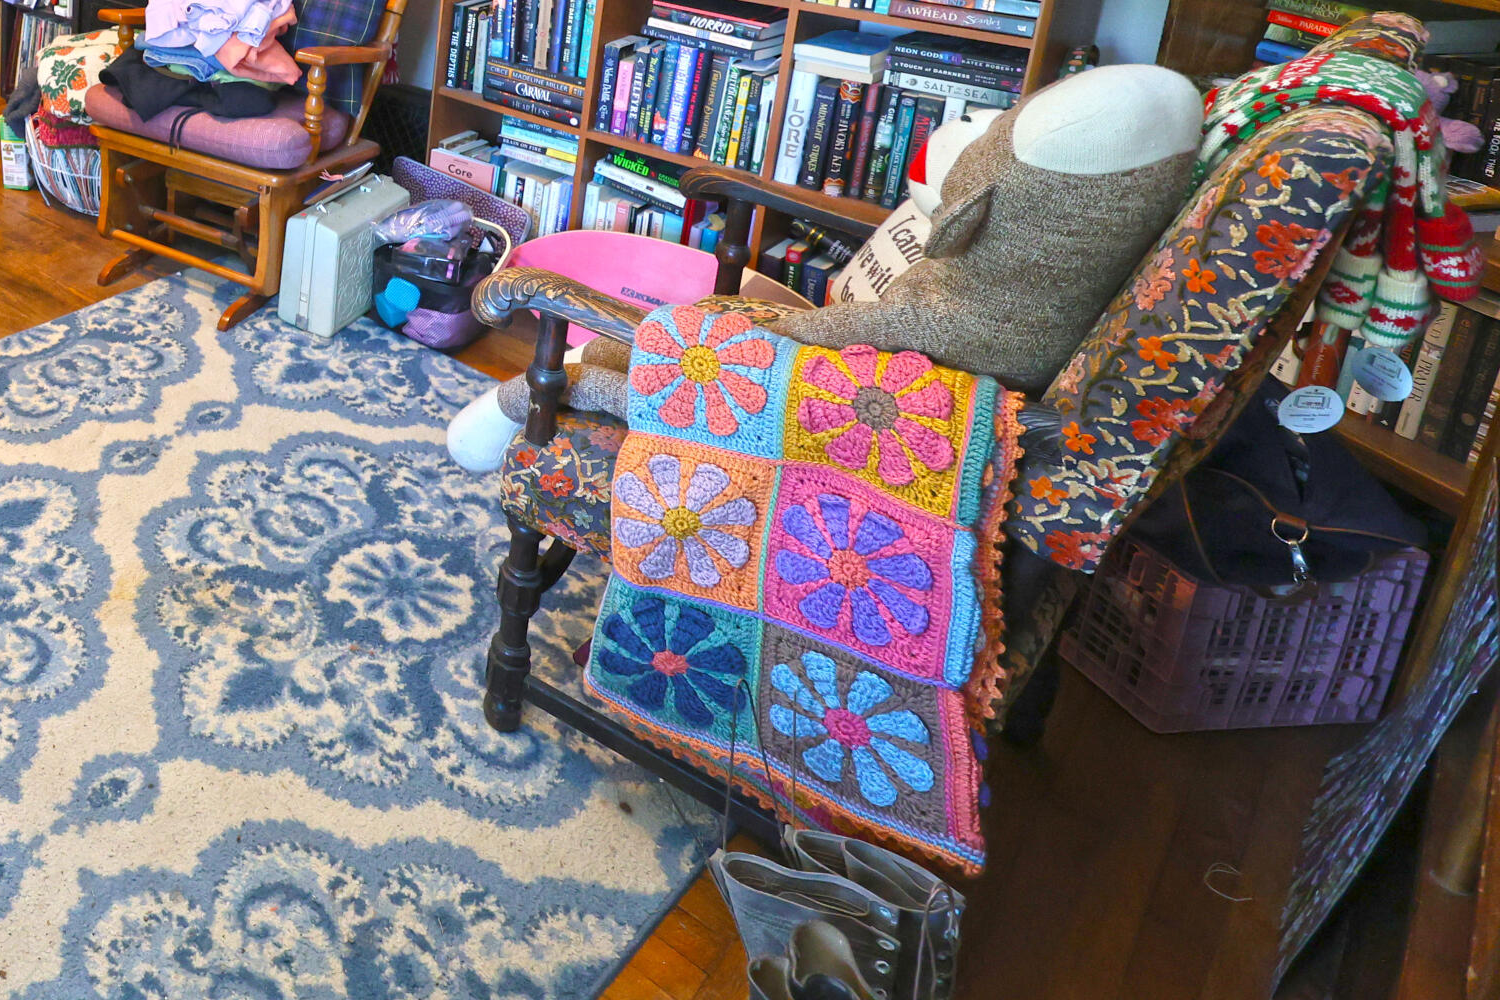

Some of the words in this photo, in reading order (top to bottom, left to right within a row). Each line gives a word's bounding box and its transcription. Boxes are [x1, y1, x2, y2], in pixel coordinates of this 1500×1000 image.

[689, 16, 734, 34] HORRID
[451, 31, 460, 47] THE
[447, 48, 460, 78] DEPTHS
[697, 53, 705, 69] WHAT
[894, 46, 919, 55] NEON
[920, 50, 944, 59] GODS
[985, 63, 1014, 72] ROBERT
[694, 70, 702, 83] LIES
[900, 62, 923, 71] TOUCH
[933, 68, 971, 79] DARKNESS
[511, 72, 545, 86] MADELINE
[546, 80, 568, 92] MILLER
[515, 82, 552, 102] CARAVAL
[923, 81, 954, 94] SALT
[963, 88, 989, 101] SEA
[629, 71, 644, 120] HELFYRE
[690, 92, 698, 104] THE
[686, 105, 695, 126] WOODS
[813, 102, 828, 141] MIDNIGHT
[886, 107, 897, 122] GIRL
[784, 98, 805, 159] LORE
[502, 138, 520, 146] BRAIN
[613, 153, 650, 177] WICKED
[808, 144, 821, 173] STRIKES
[447, 163, 473, 179] Core
